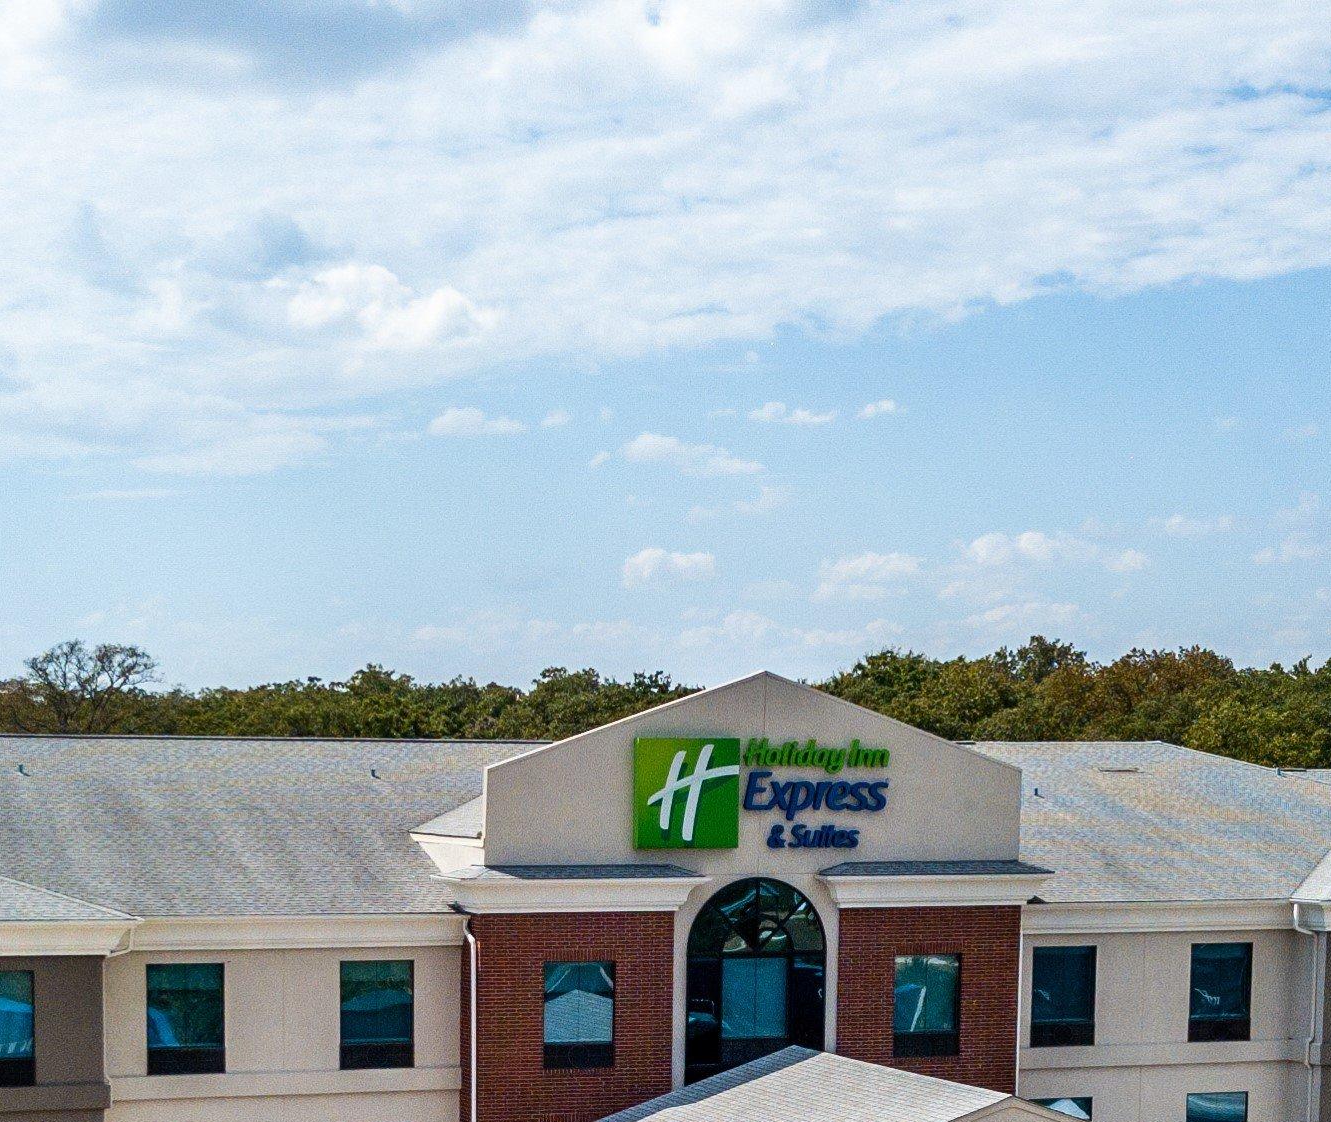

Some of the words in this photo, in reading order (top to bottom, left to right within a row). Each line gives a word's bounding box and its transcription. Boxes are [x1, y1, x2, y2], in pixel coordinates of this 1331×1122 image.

[743, 738, 846, 774] Holiday
[847, 738, 890, 767] Inn
[743, 771, 889, 821] Express
[766, 824, 786, 848] &
[788, 824, 860, 848] Suites
